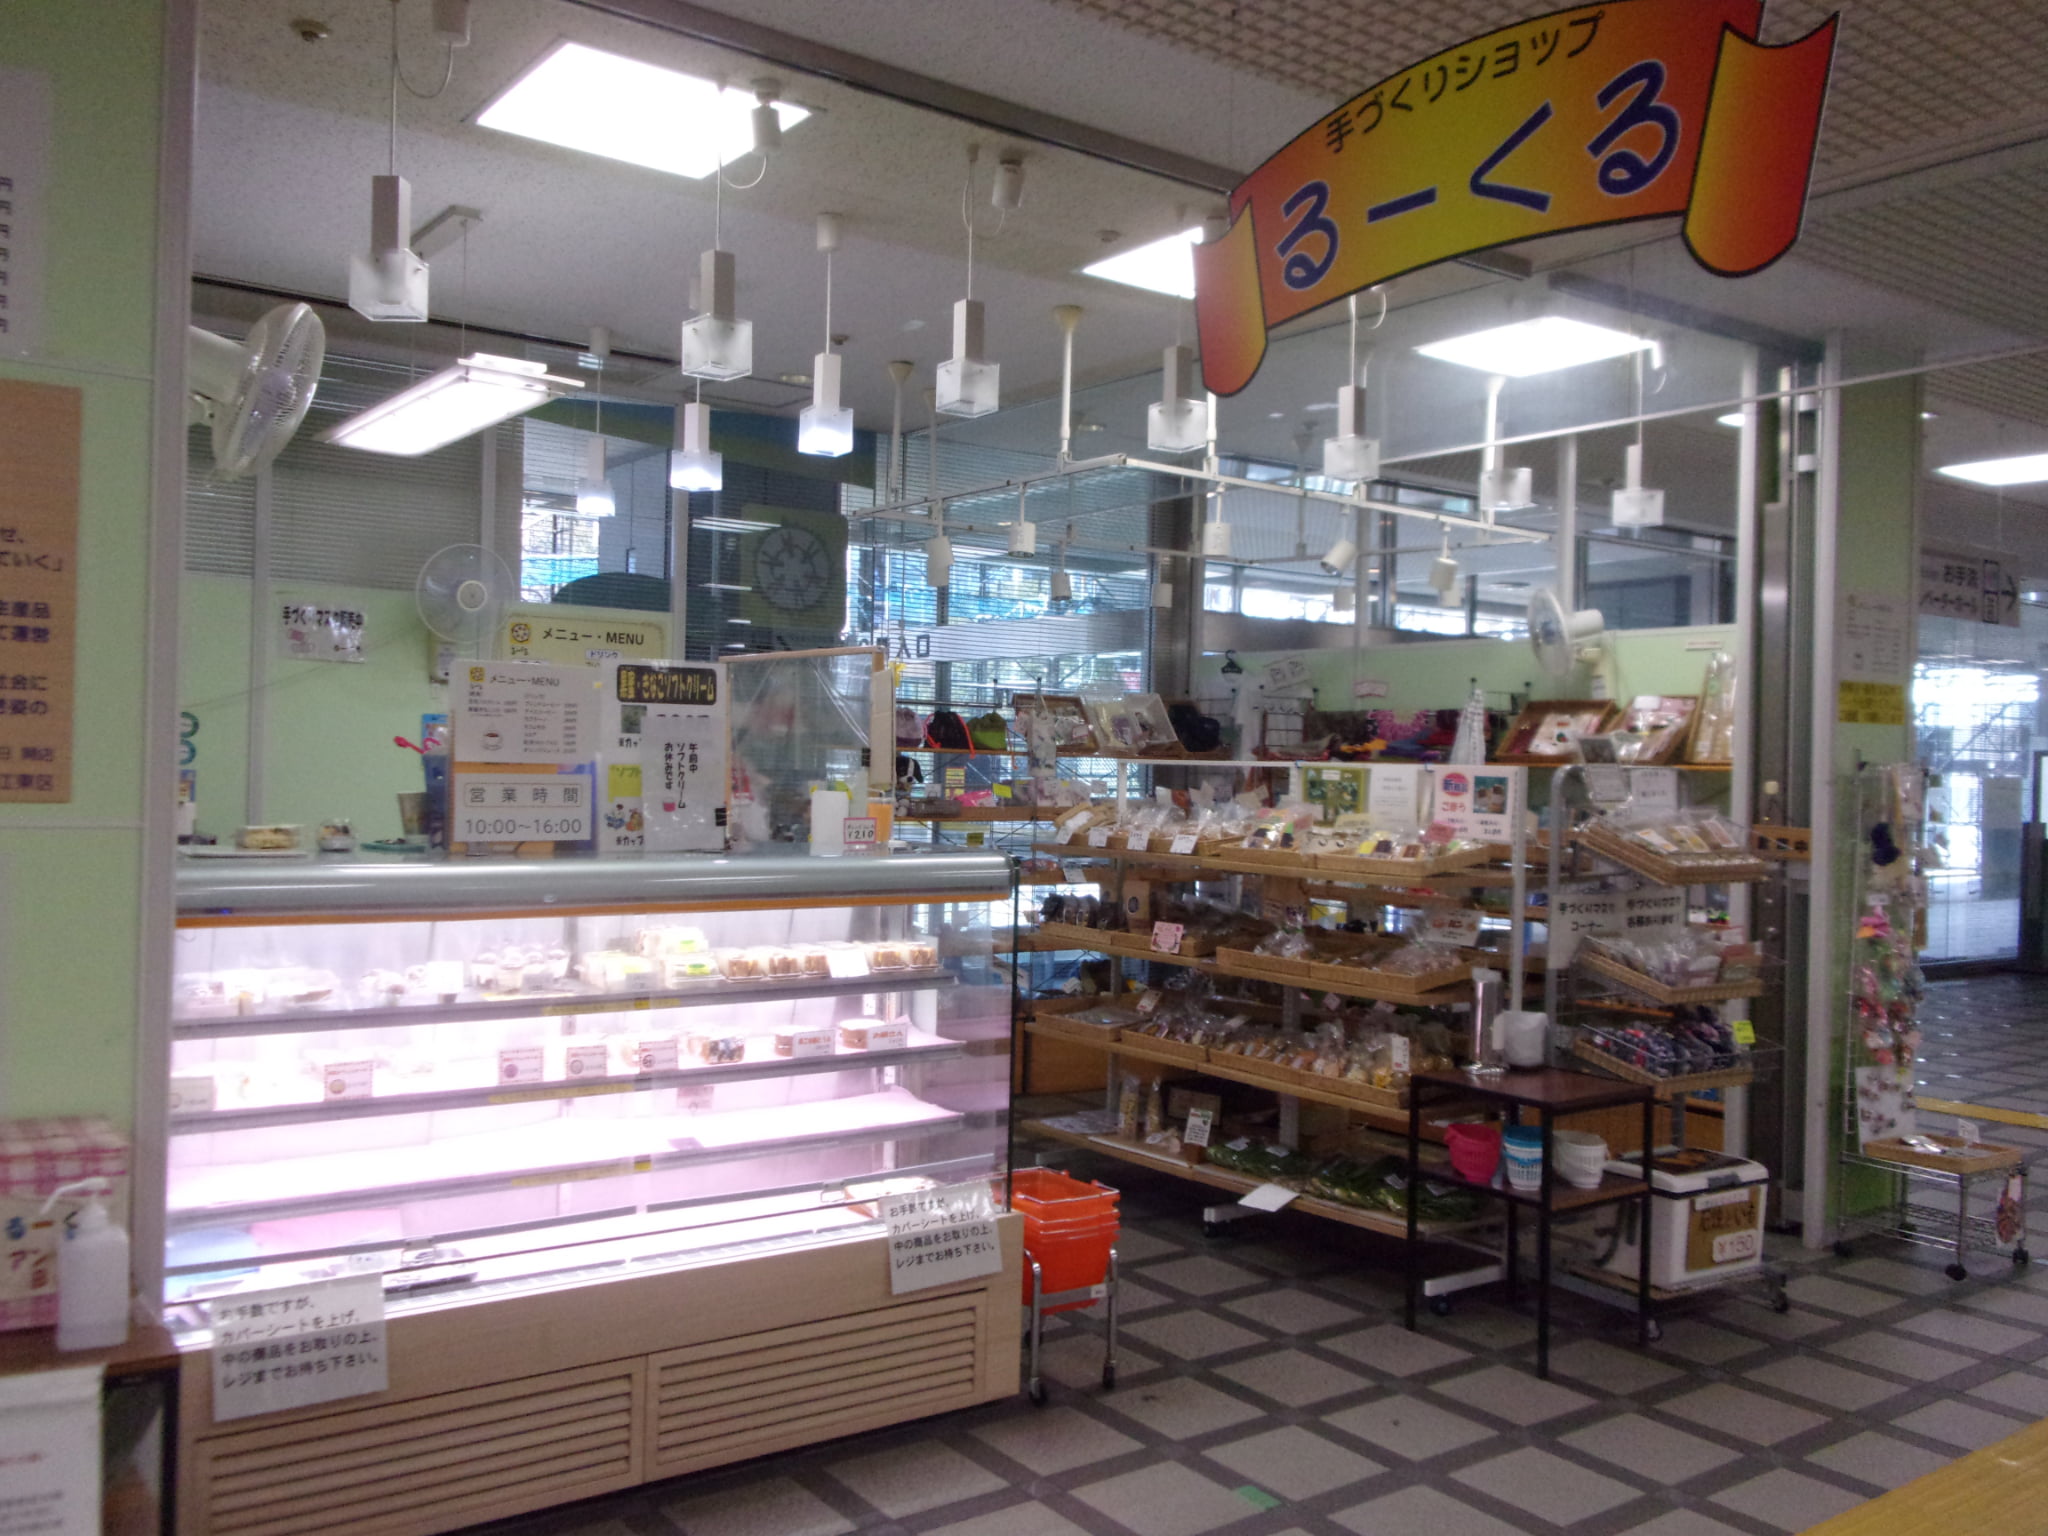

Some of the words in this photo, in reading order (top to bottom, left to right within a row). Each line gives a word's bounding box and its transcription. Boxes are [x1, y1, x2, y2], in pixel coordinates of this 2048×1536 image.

[1324, 11, 1606, 154] 手づくりショップ
[1276, 59, 1681, 292] るーくる
[469, 786, 580, 804] 営業時間
[892, 1210, 980, 1236] カバーシートを上げ、
[894, 1224, 993, 1250] 中の商品をお取りの上、
[896, 1243, 996, 1269] レジまでお待ち下さい。
[222, 1309, 360, 1344] カバーシートを上げ、
[221, 1331, 379, 1367] 中の商品をお取りの上、
[222, 1352, 379, 1389] レジまでお待ち下さい。
